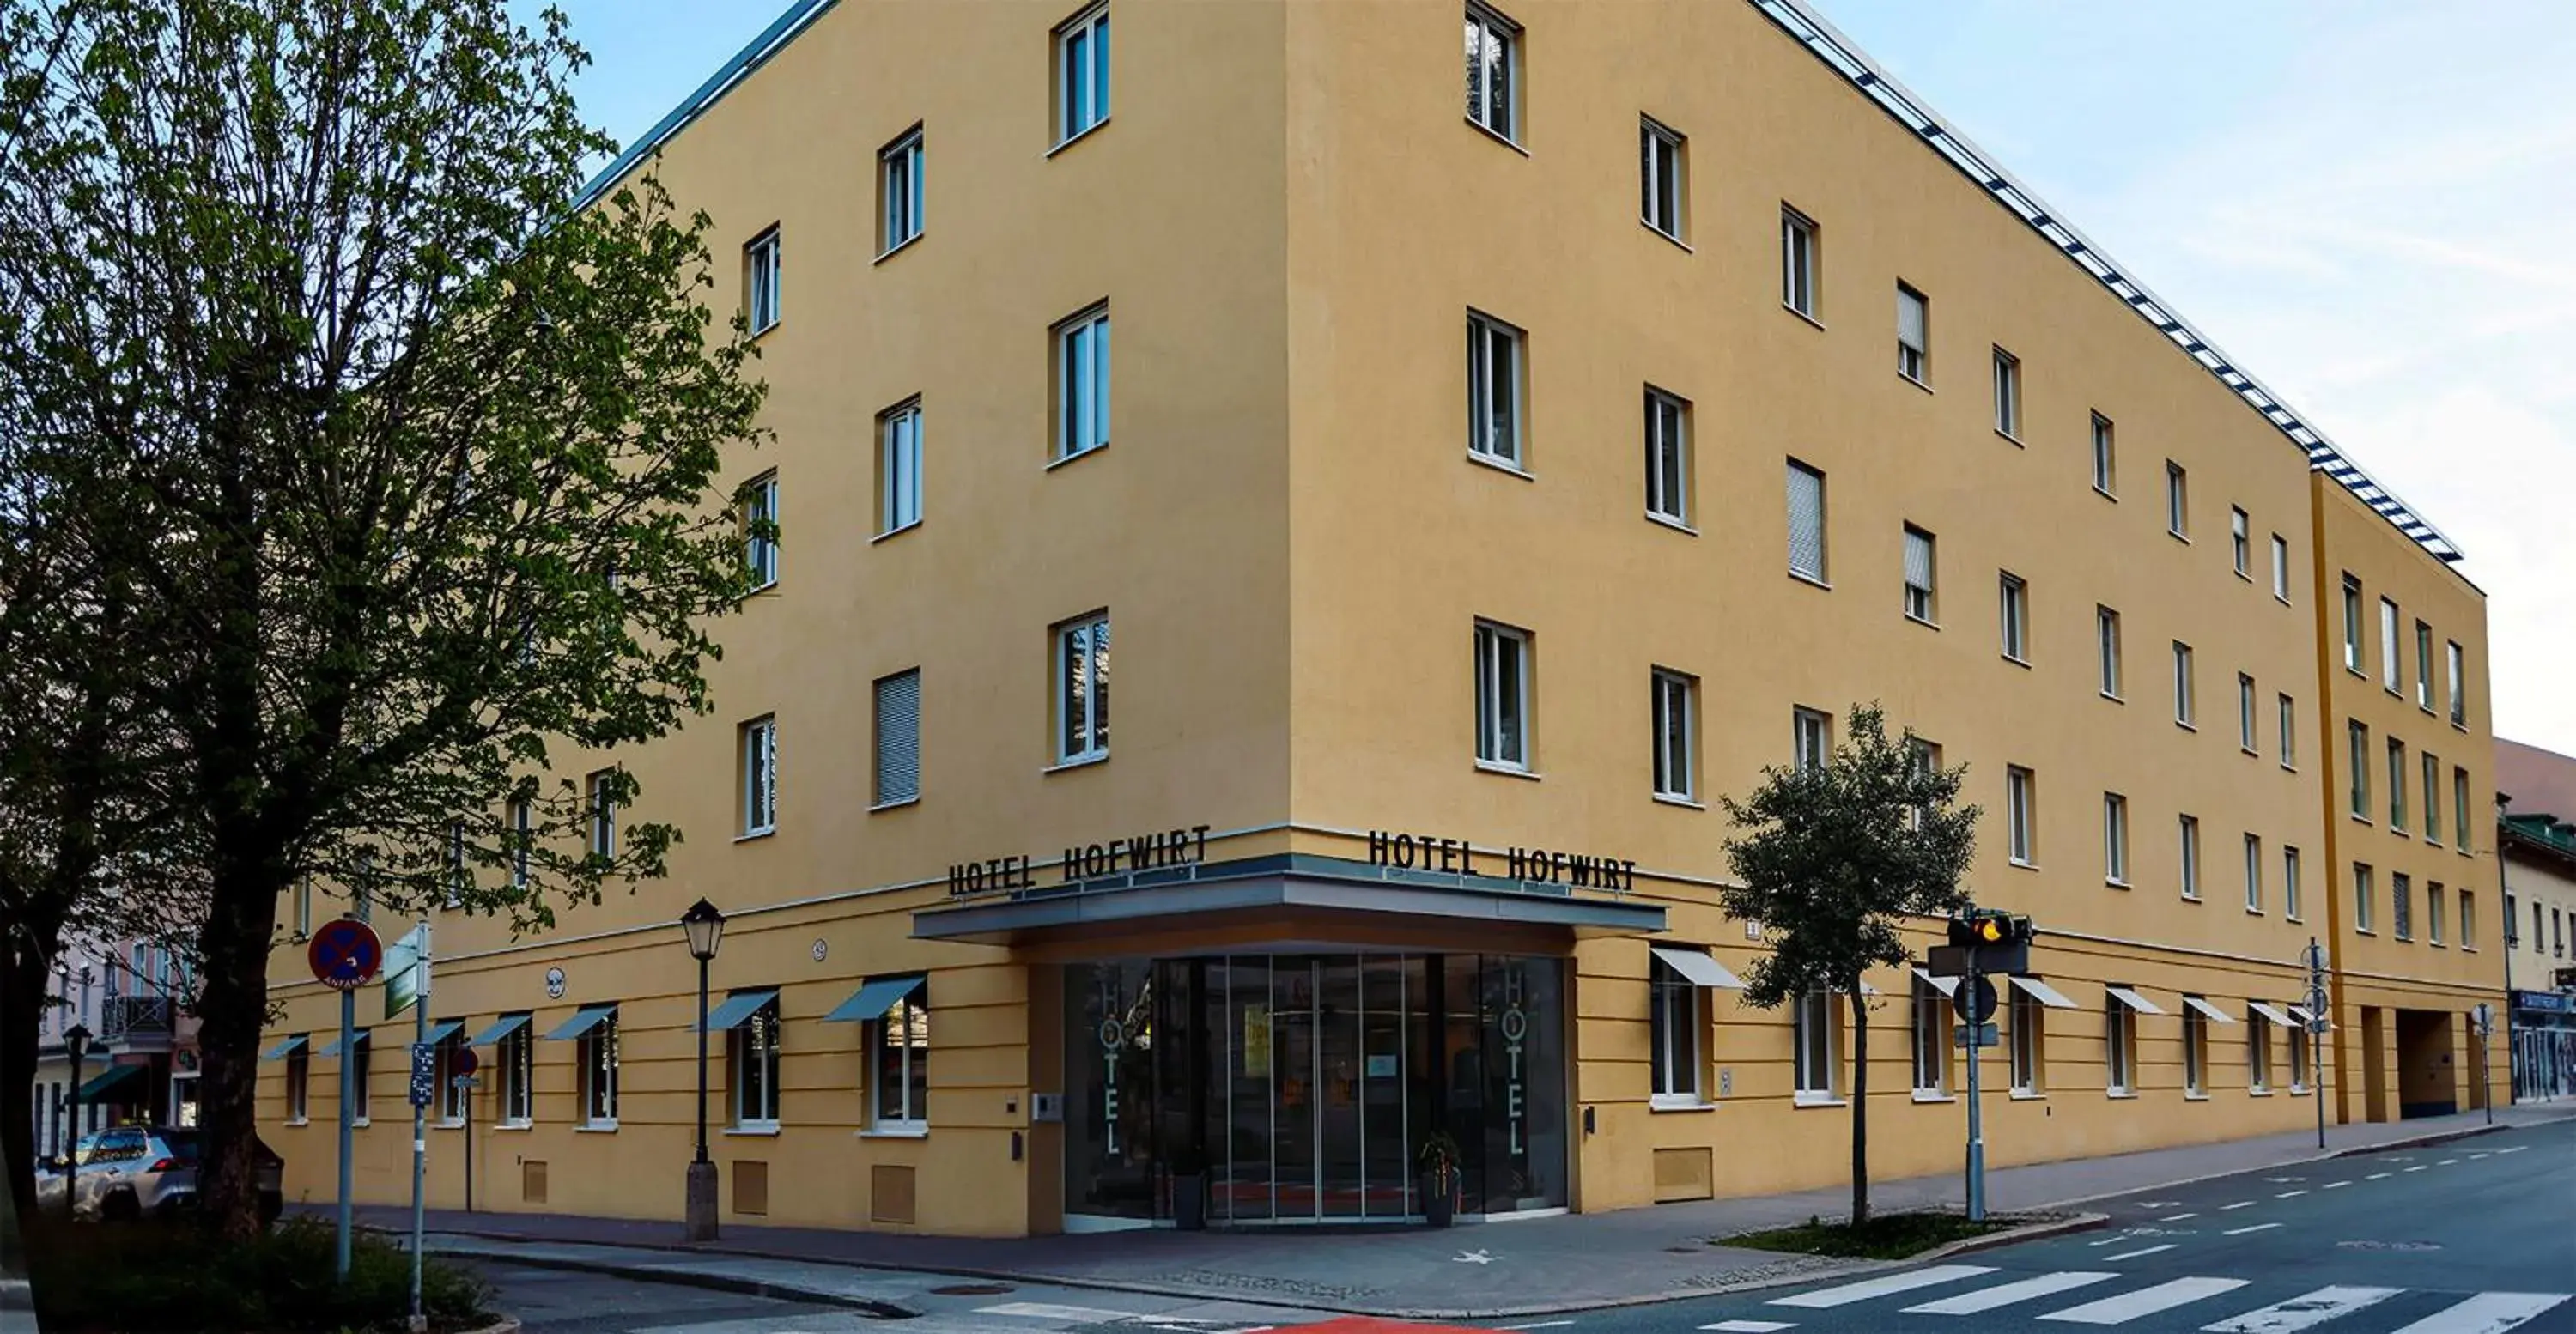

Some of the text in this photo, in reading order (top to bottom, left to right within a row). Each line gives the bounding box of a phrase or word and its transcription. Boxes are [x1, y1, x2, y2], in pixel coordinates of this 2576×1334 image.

[949, 825, 1210, 895] HOTEL HOFWIRT
[1370, 830, 1636, 890] HOTEL HOFWIRT
[325, 975, 367, 989] ANFANG
[1101, 982, 1121, 1154] HOTEL
[1503, 970, 1526, 1155] HOTEL
